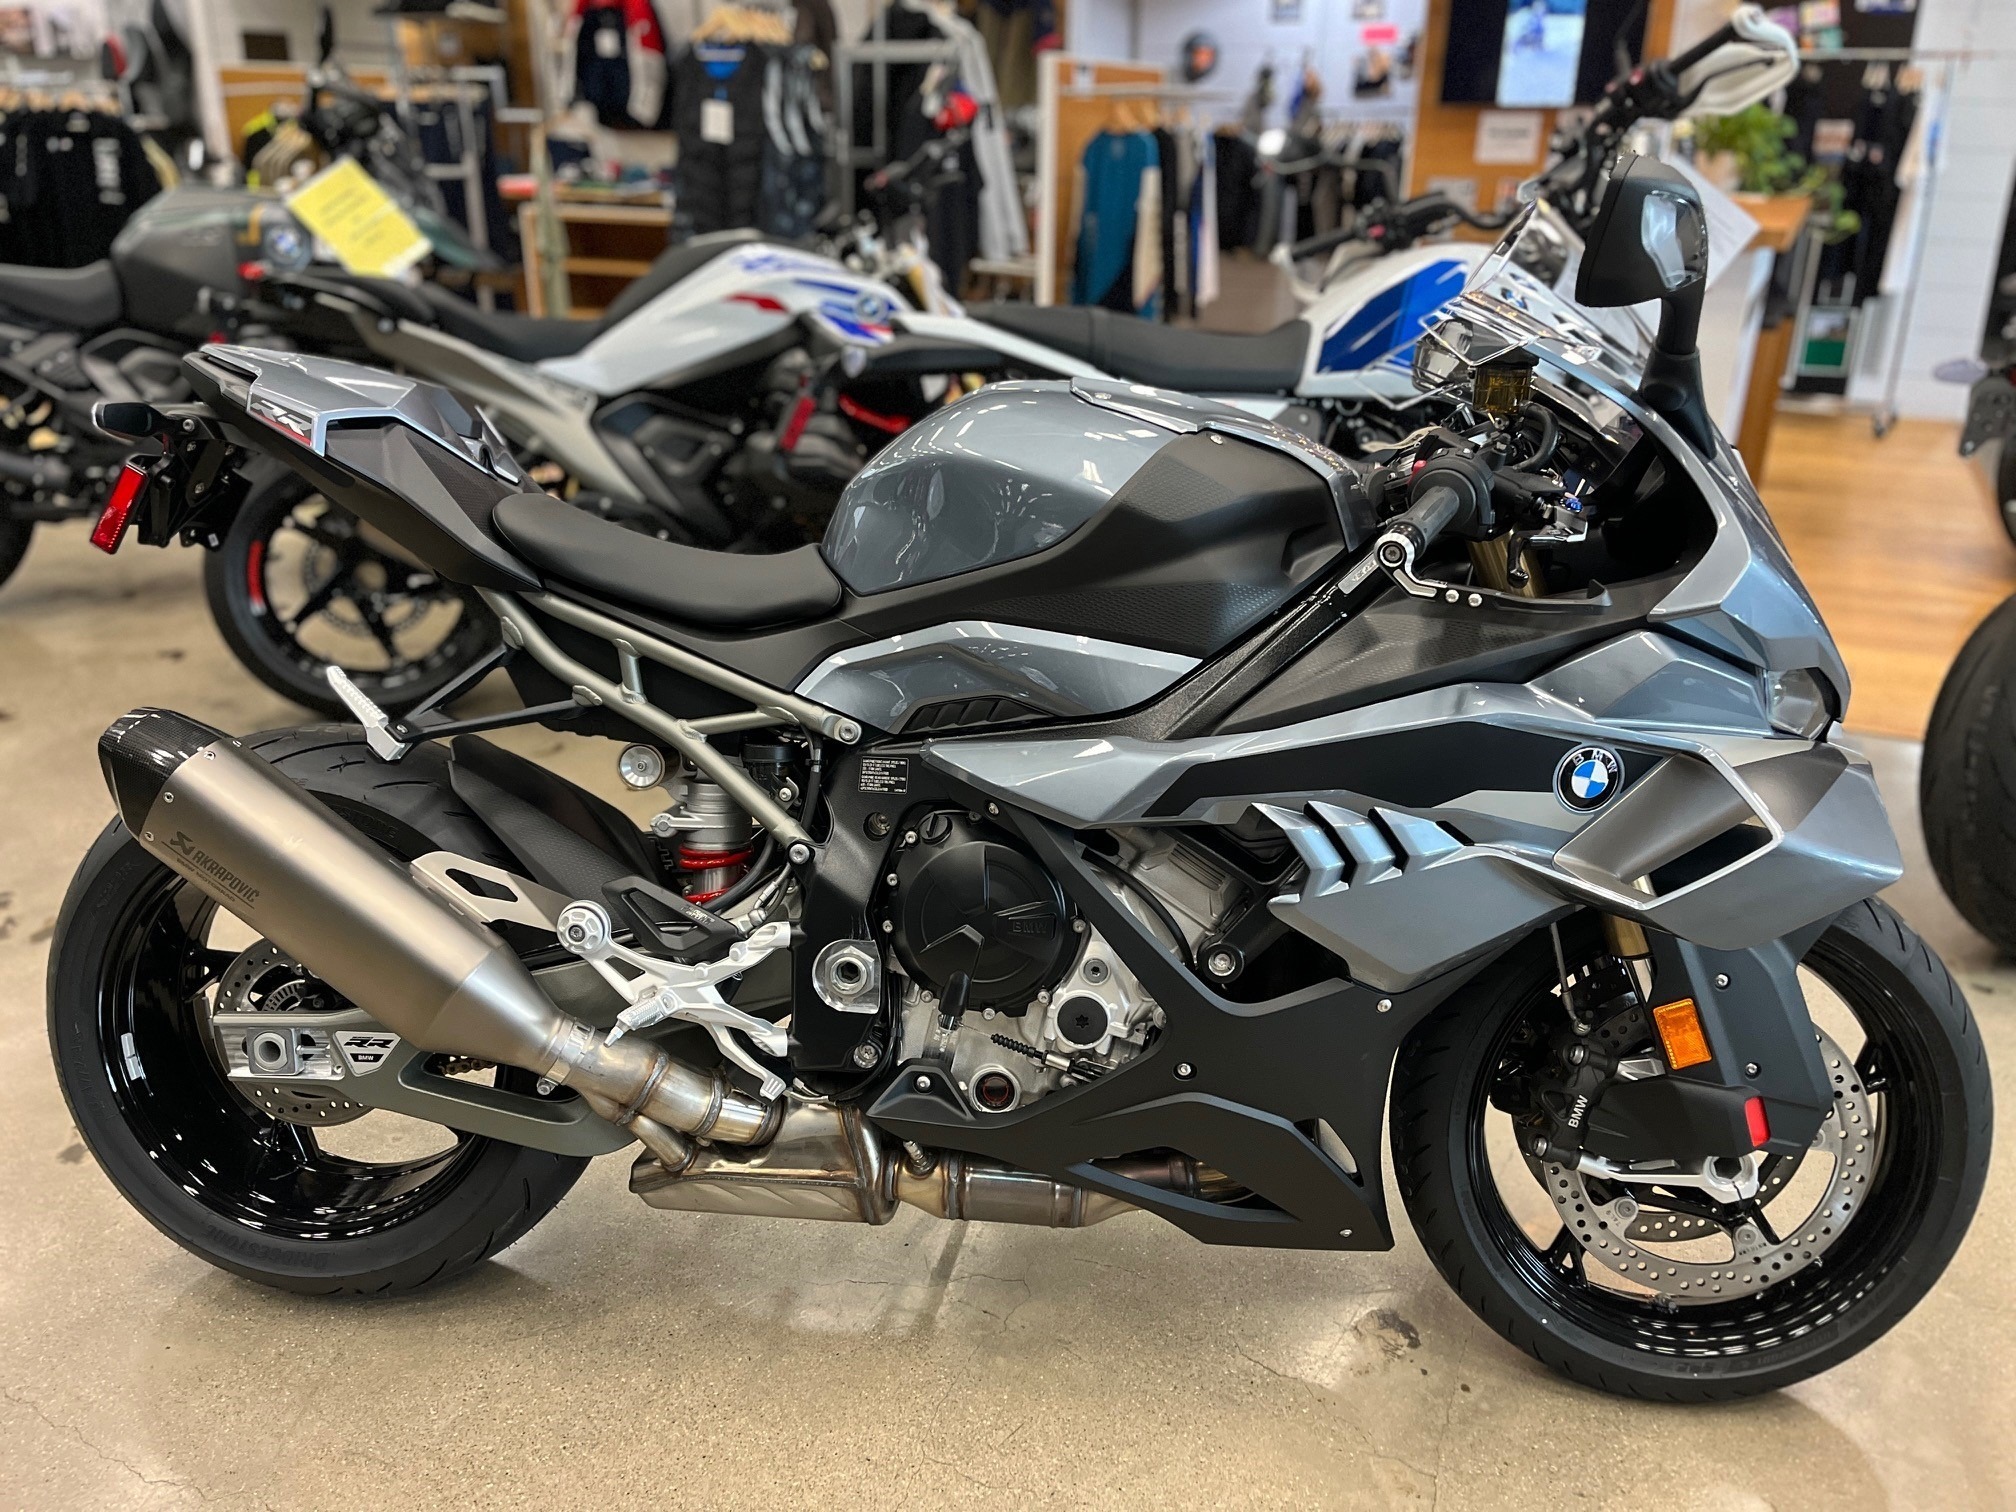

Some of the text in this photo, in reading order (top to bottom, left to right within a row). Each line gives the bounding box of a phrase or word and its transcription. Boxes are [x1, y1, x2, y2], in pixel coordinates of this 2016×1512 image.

[250, 400, 312, 437] RR
[1572, 748, 1618, 774] BMW
[1012, 920, 1049, 935] BMW
[344, 1036, 395, 1049] RR
[1567, 1094, 1589, 1128] BMW
